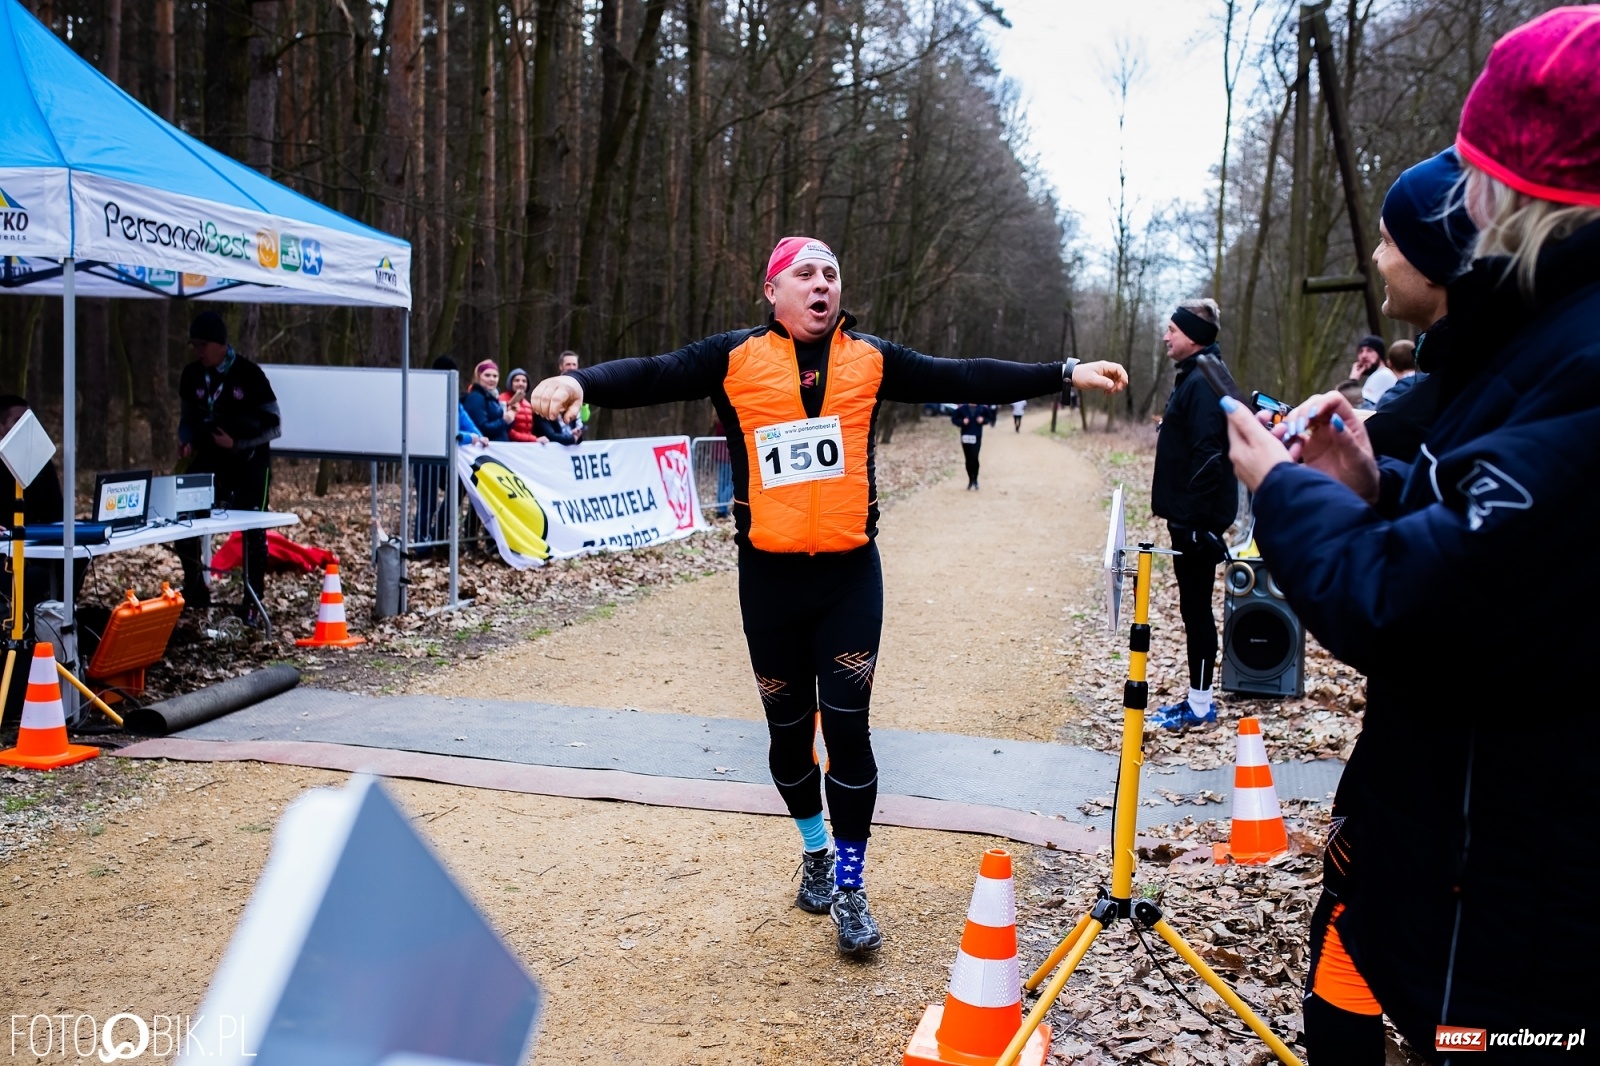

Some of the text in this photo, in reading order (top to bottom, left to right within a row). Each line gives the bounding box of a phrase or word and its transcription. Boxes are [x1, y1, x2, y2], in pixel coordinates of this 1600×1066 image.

[103, 201, 251, 260] PersonalBest
[570, 452, 611, 480] BIEG
[765, 438, 839, 475] 150
[552, 486, 658, 525] TWARDZIELA
